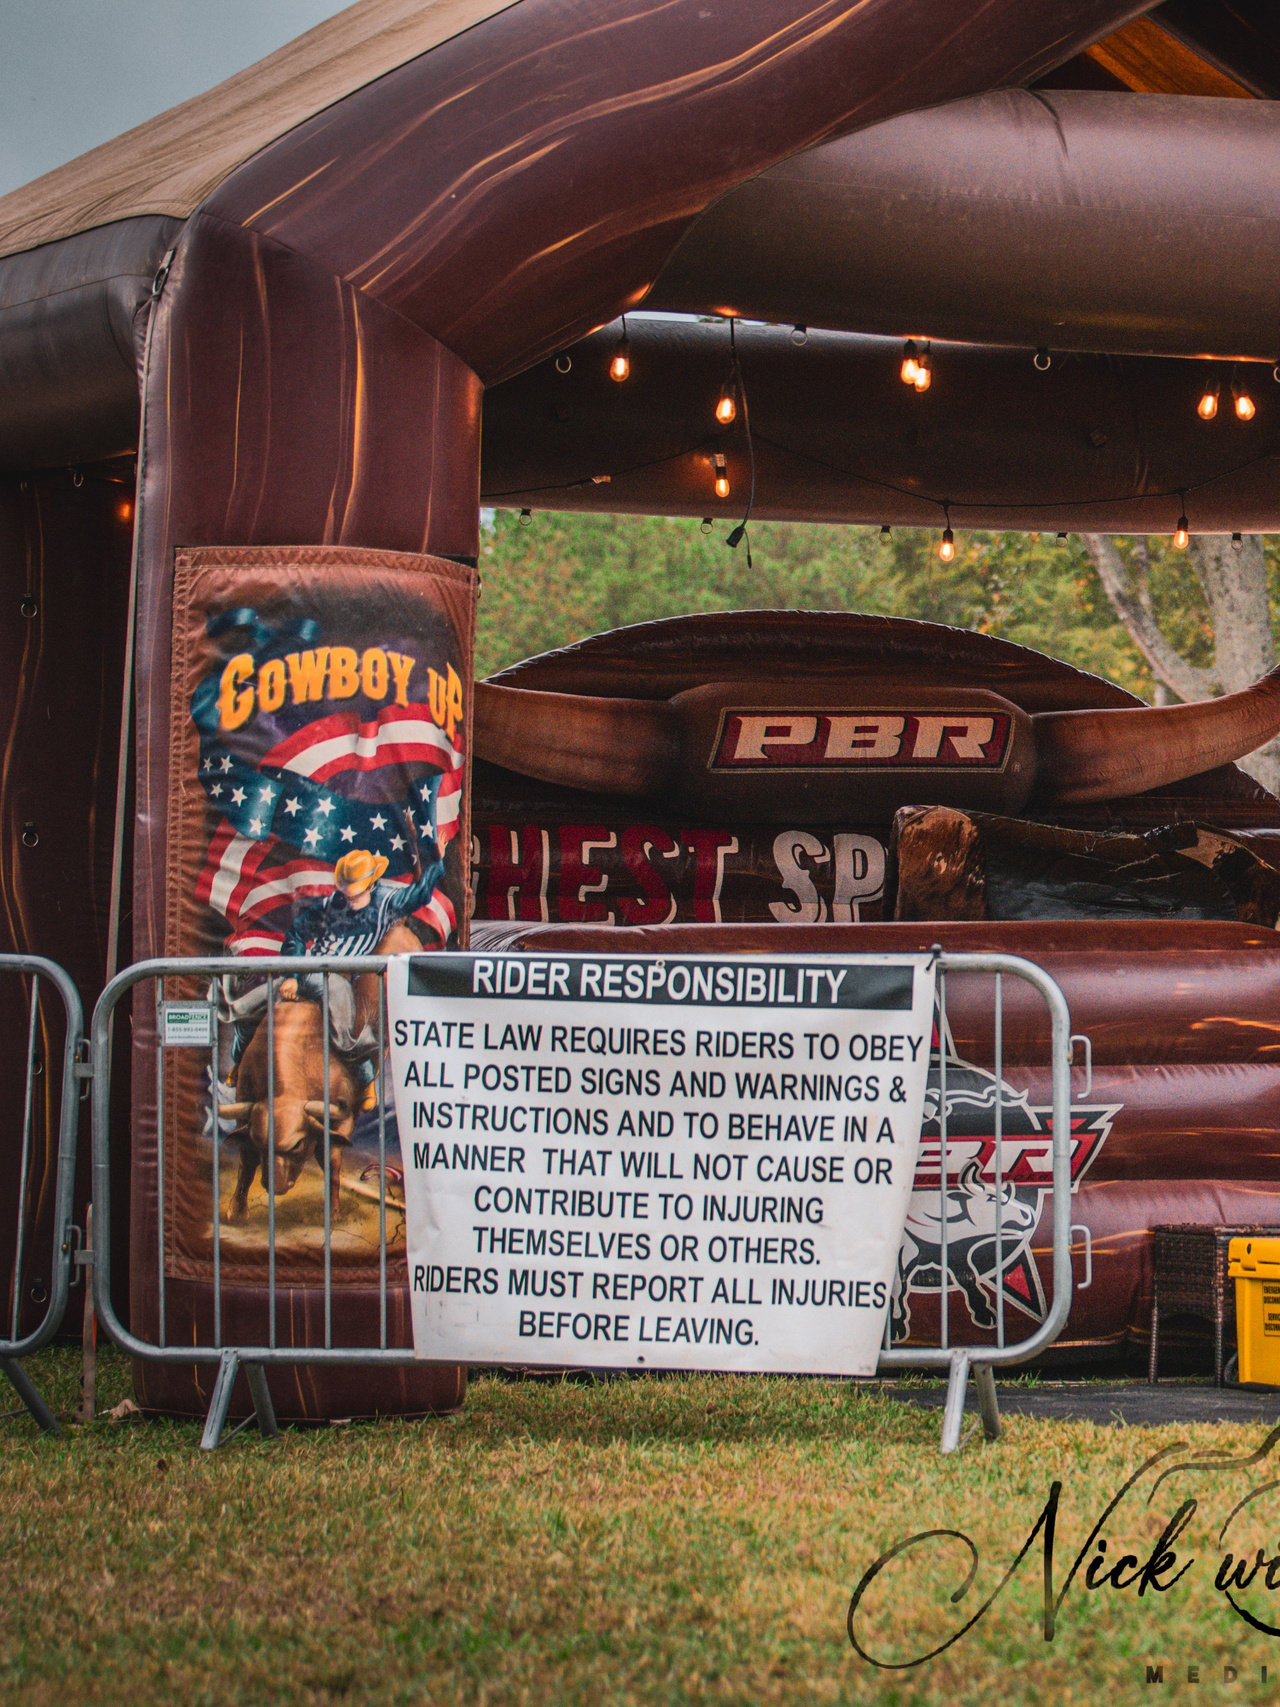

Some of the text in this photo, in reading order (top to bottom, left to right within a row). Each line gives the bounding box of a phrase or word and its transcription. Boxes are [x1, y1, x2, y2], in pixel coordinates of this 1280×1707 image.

[216, 646, 464, 742] COWBOY UP
[733, 716, 994, 759] PBR
[470, 825, 739, 923] HEST
[474, 960, 847, 1003] RIDER RESPONSIBILITY
[395, 1020, 923, 1062] STATE LAW REQUIRES RIDERS TO OBEY
[404, 1061, 906, 1102] ALL POSTED SIGNS AND WARNINGS &
[414, 1102, 894, 1143] INSTRUCTIONS AND TO BEHAVE IN A
[414, 1143, 892, 1184] MANNER THAT WILL NOT CAUSE OR
[475, 1186, 823, 1224] CONTRIBUTE TO INJURING
[473, 1226, 820, 1264] THEMSELVES OR OTHERS.
[414, 1265, 886, 1309] RIDERS MUST REPORT ALL INJURIES
[519, 1311, 758, 1345] BEFORE LEAVING.
